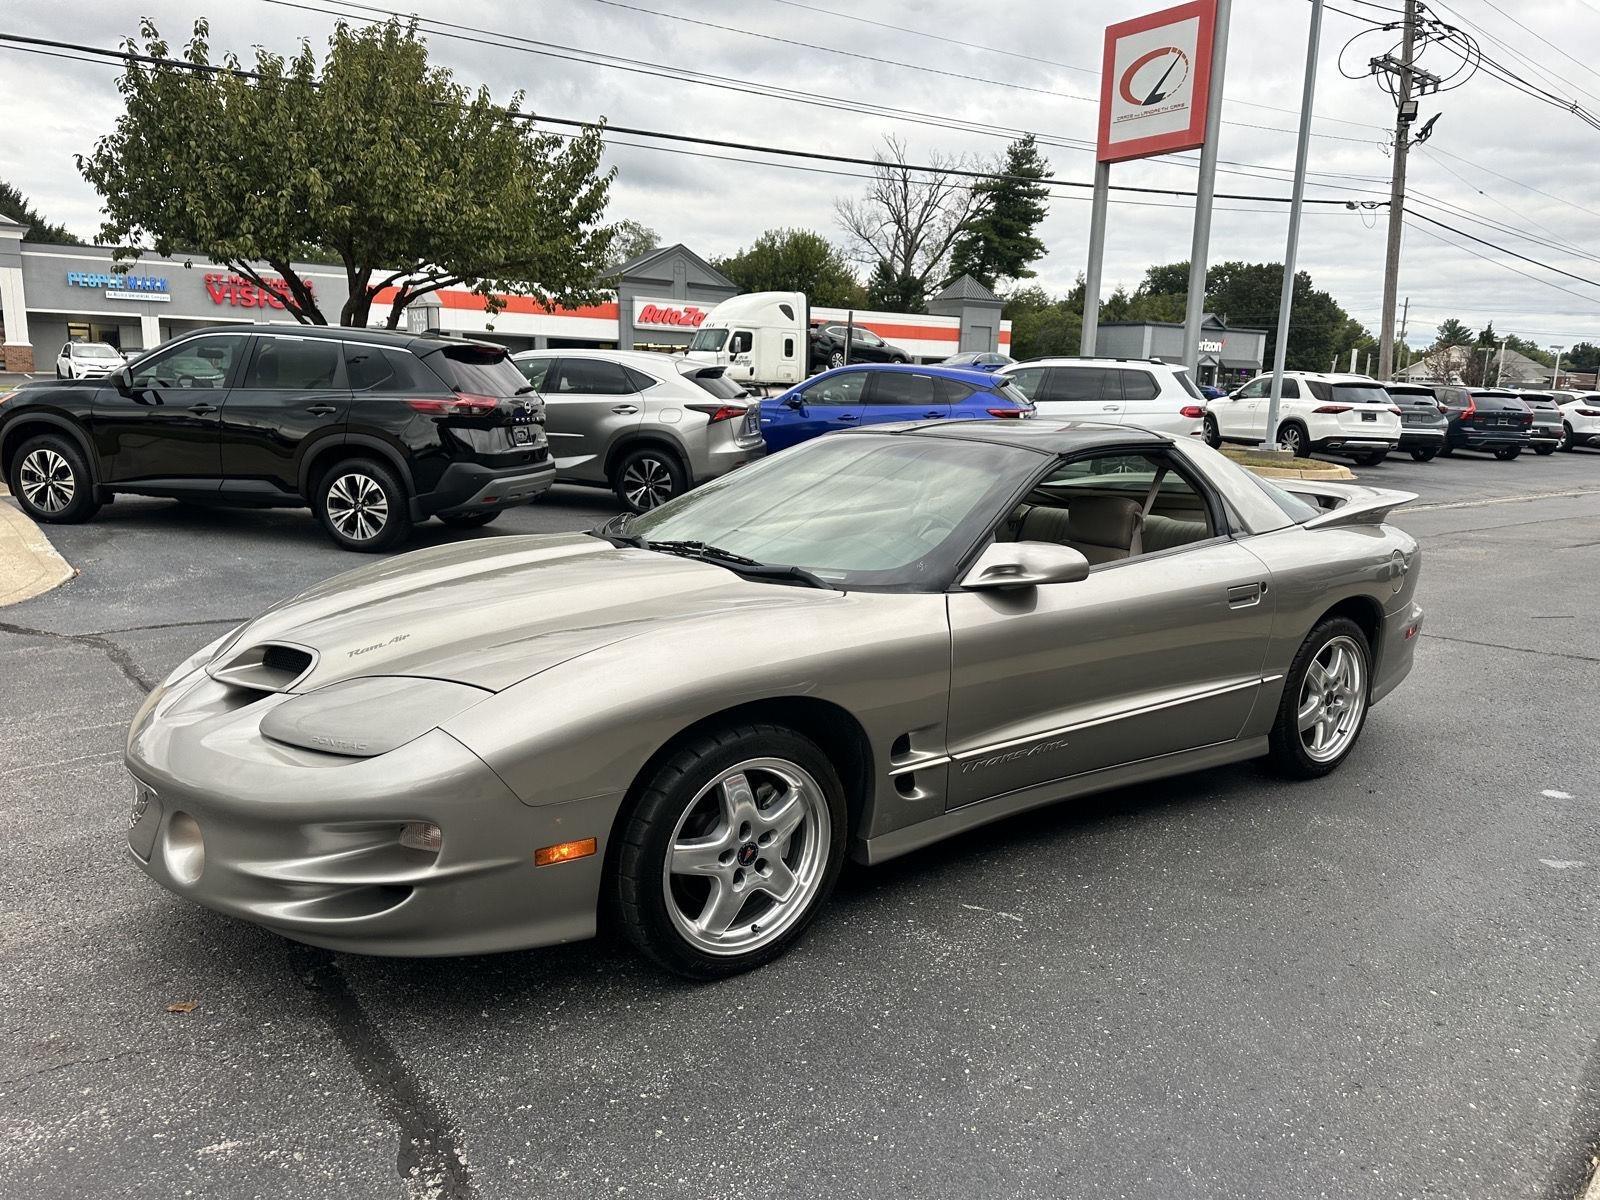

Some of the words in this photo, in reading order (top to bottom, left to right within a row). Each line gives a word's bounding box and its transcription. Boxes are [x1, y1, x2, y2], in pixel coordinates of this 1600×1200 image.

[1170, 102, 1185, 110] CARS
[67, 271, 125, 289] PEOPLE
[127, 275, 169, 292] MARK
[205, 283, 304, 309] VISIO
[638, 304, 706, 327] AutoZo
[347, 643, 386, 658] Ram
[388, 633, 410, 645] Air
